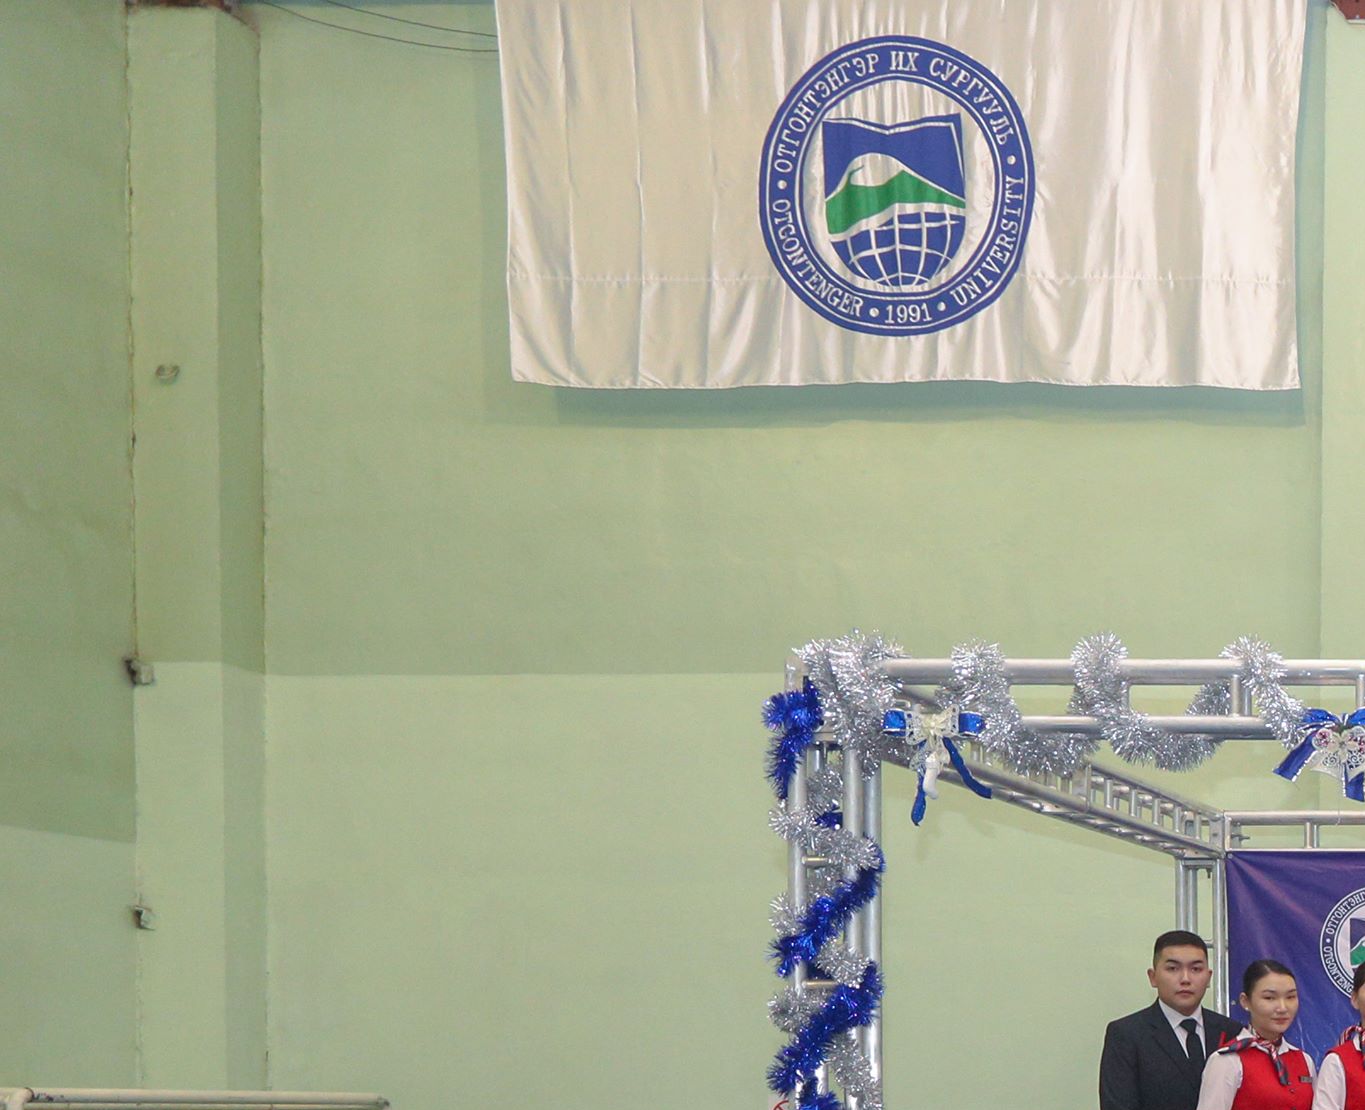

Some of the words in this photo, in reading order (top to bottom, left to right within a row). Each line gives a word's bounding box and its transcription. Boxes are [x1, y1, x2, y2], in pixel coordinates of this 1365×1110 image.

[774, 52, 880, 173] ОТГОНТЭНГЭР
[889, 50, 920, 72] ИХ
[929, 57, 1015, 146] СУРГУУЛЬ
[885, 303, 932, 324] 1991
[951, 175, 1024, 306] UNIVERSITY
